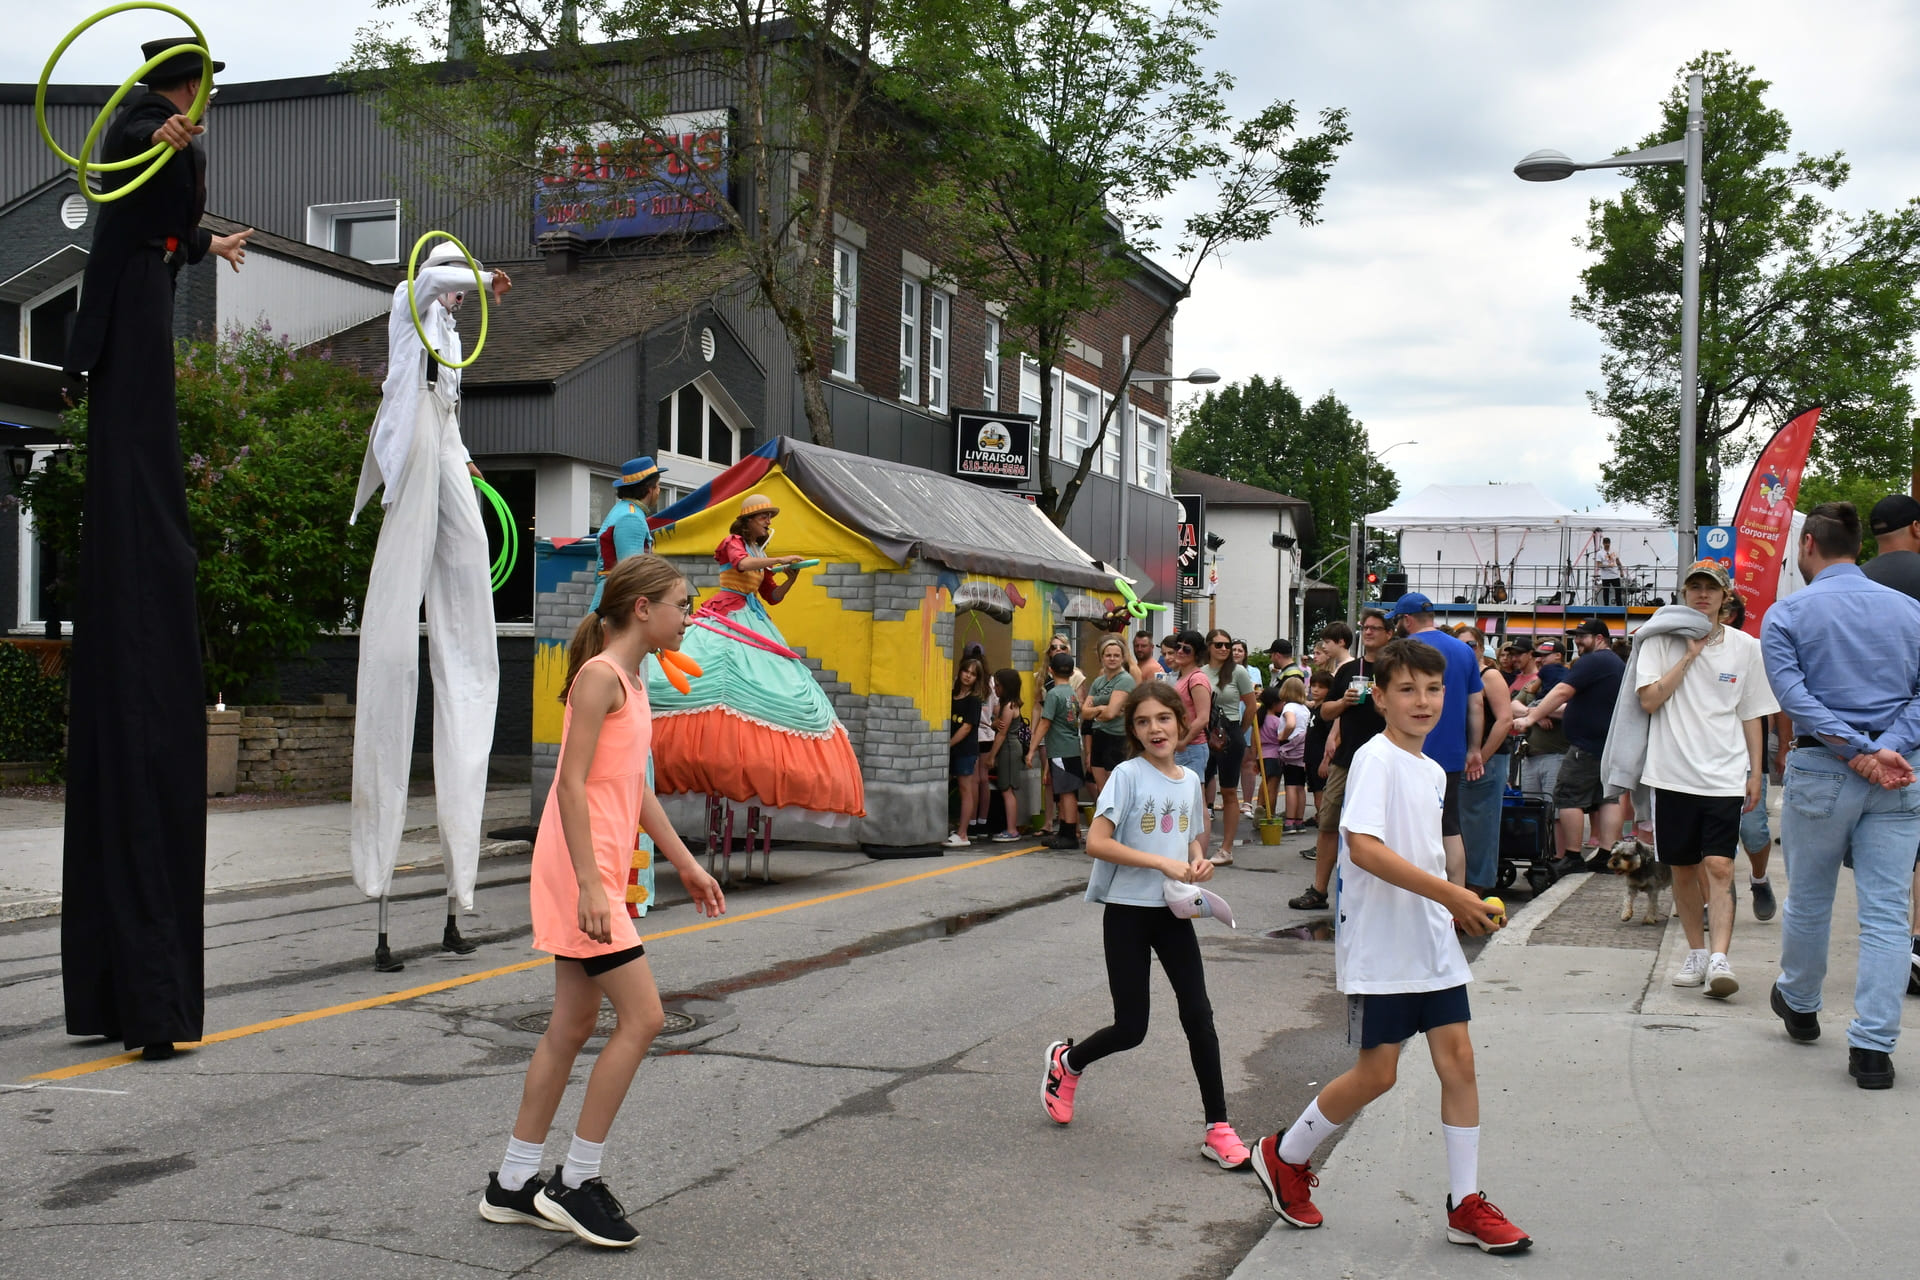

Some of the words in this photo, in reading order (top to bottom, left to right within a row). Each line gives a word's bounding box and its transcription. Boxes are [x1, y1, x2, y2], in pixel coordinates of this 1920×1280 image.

[965, 450, 1023, 465] LIVRAISON
[1708, 533, 1726, 543] STS
[1739, 525, 1780, 542] Corporatif
[1177, 546, 1198, 567] UM
